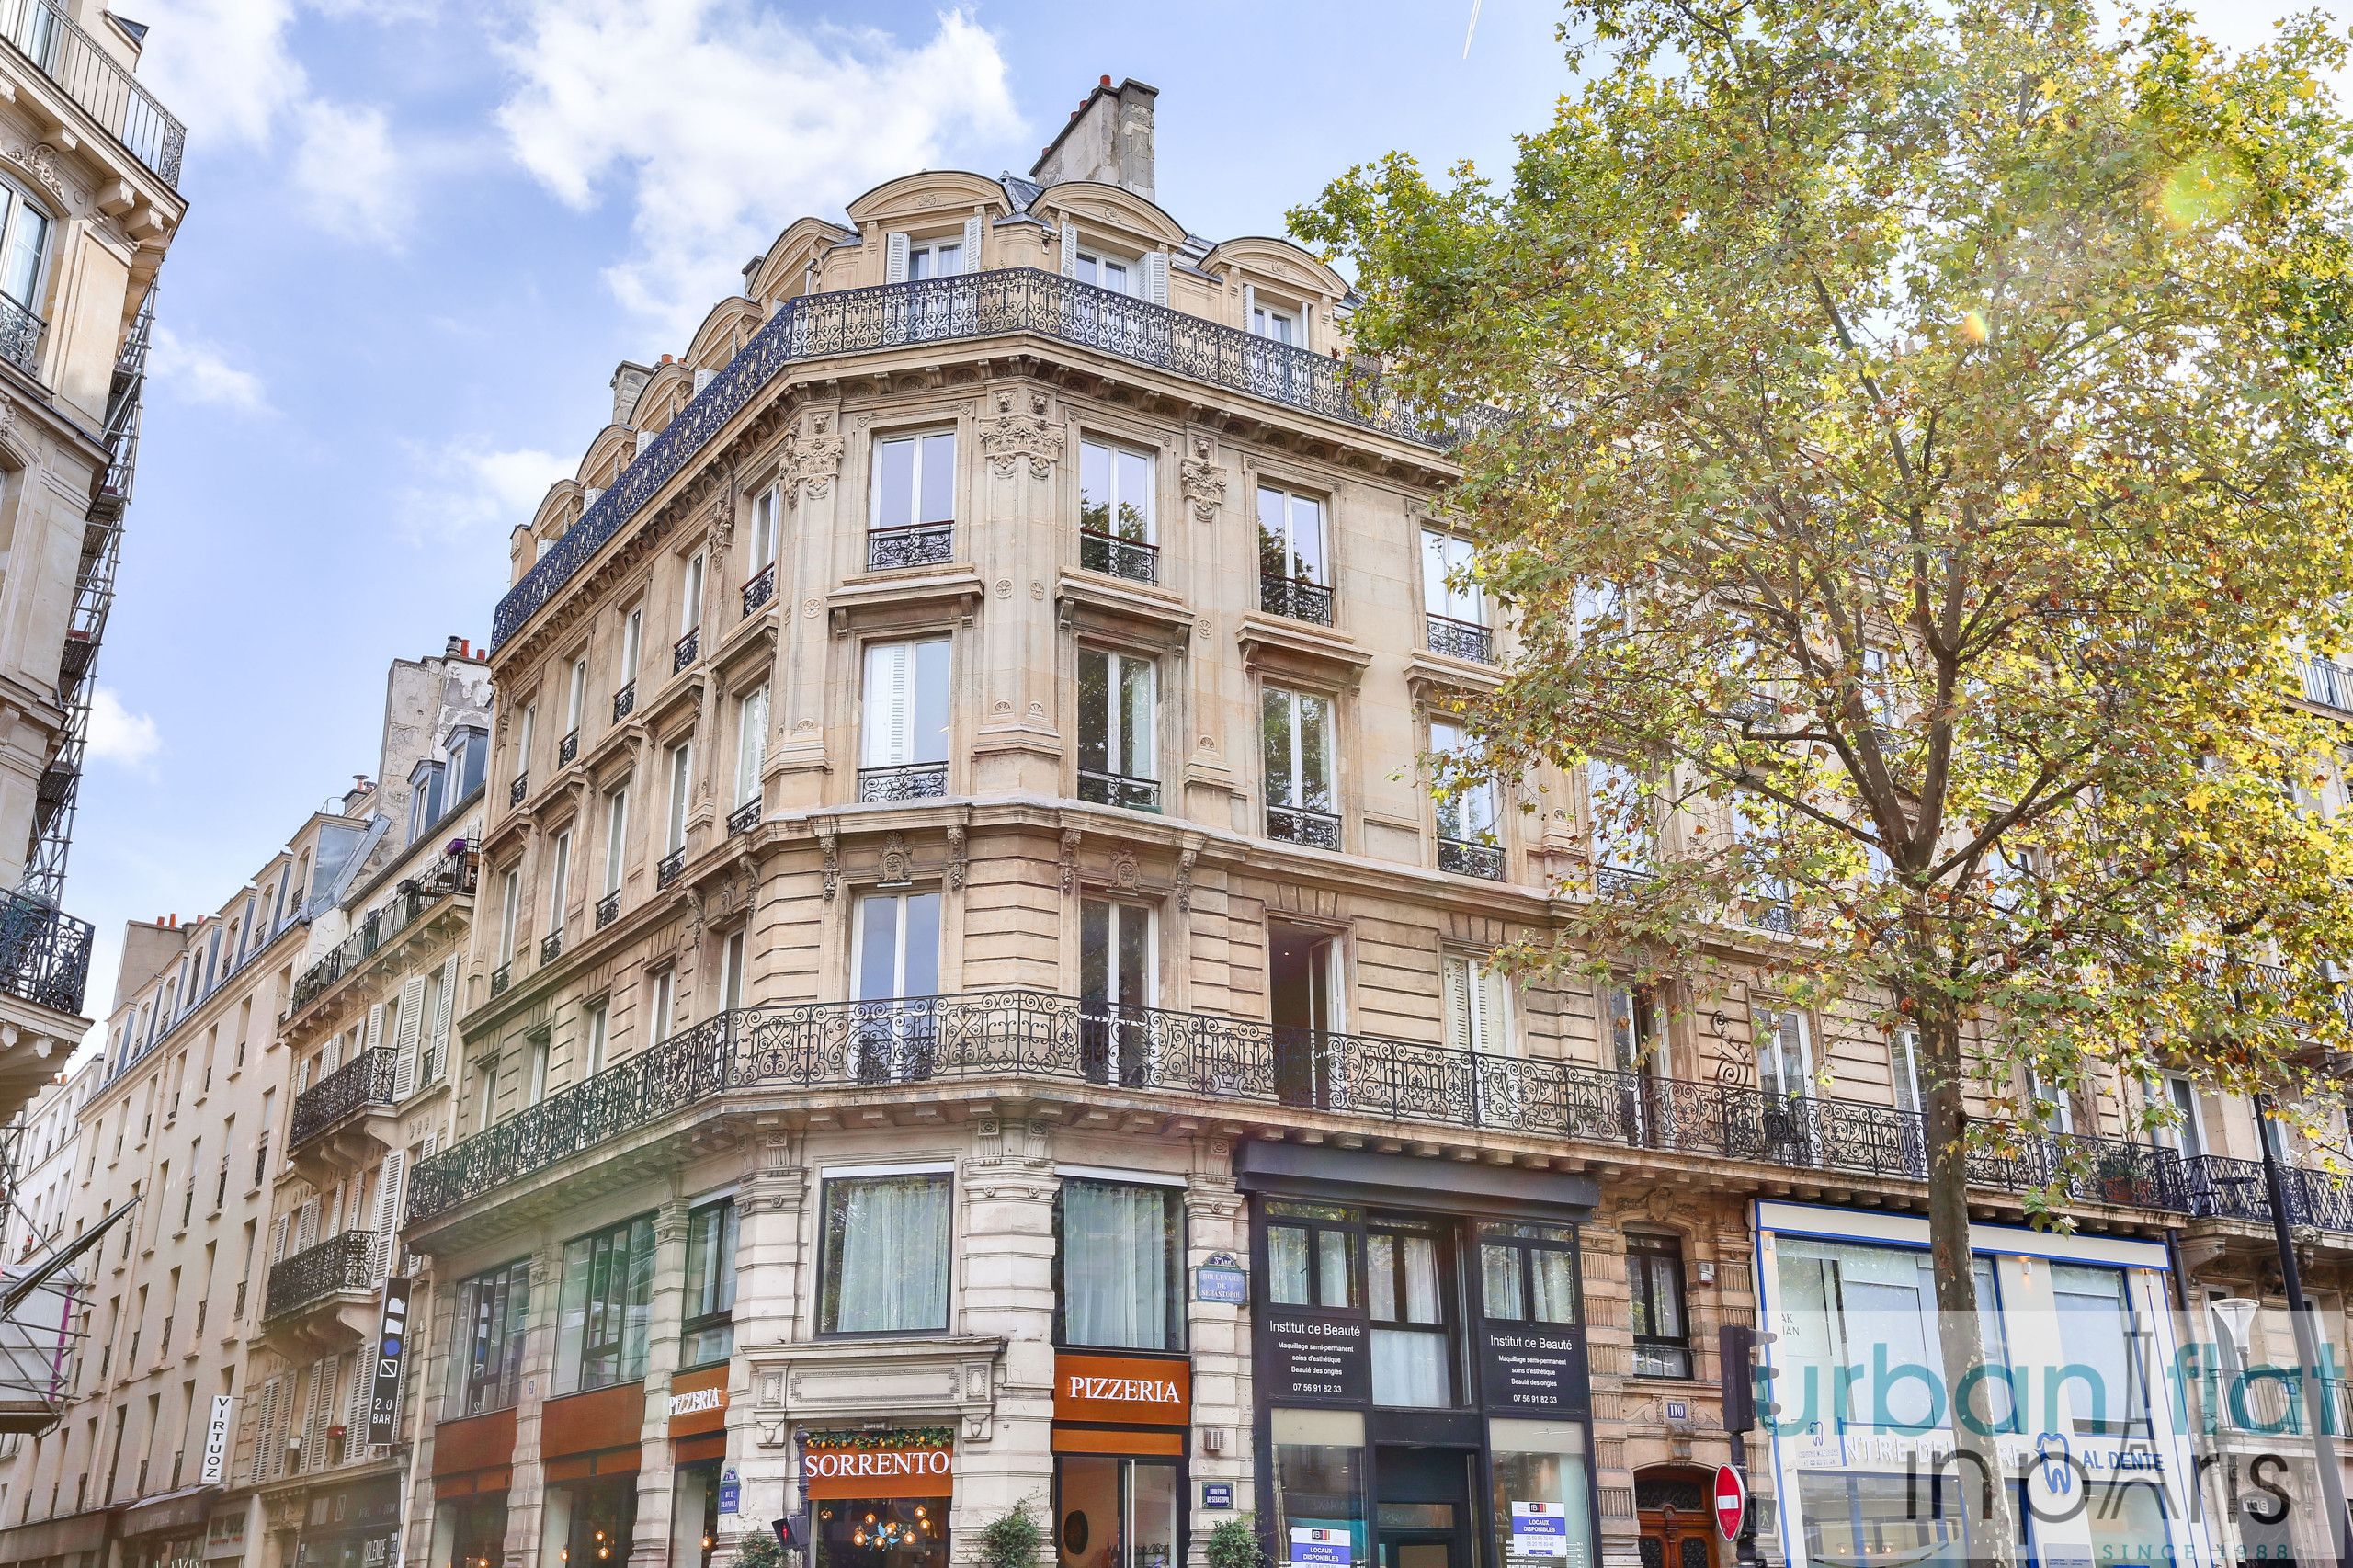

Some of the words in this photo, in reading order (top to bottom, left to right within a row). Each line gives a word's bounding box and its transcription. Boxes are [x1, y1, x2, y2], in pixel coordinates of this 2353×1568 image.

[1269, 1320, 1305, 1334] Institut
[1308, 1323, 1321, 1335] de
[1324, 1324, 1360, 1337] Beauté
[1278, 1341, 1309, 1351] Maquillage
[1309, 1344, 1354, 1353] semi-permanent
[1490, 1335, 1522, 1347] Institut
[1524, 1337, 1537, 1348] de
[1539, 1337, 1573, 1351] Beauté
[1308, 1355, 1341, 1364] d'esthétique
[1498, 1355, 1526, 1364] Maquillage
[1527, 1357, 1566, 1366] semi-permanent
[1290, 1365, 1312, 1374] Beauté
[1324, 1368, 1343, 1377] ongles
[1526, 1368, 1556, 1377] d'esthétique
[1292, 1382, 1302, 1392] 07
[1302, 1383, 1312, 1392] 56
[1313, 1383, 1322, 1392] 91
[1323, 1384, 1332, 1392] 82
[1333, 1385, 1342, 1393] 33
[1511, 1378, 1529, 1386] Beauté
[1540, 1380, 1557, 1388] ongles
[1069, 1376, 1181, 1403] PIZZERIA
[669, 1387, 722, 1416] PIZZERIA
[1513, 1394, 1521, 1403] 07
[1522, 1394, 1530, 1403] 56
[1540, 1395, 1549, 1403] 82
[1549, 1396, 1557, 1404] 33
[1670, 1404, 1684, 1417] 110
[372, 1413, 392, 1425] BAR
[206, 1397, 230, 1478] VIRTUOZ
[804, 1450, 950, 1478] SORRENTO
[2082, 1449, 2104, 1470] AL
[2108, 1450, 2165, 1472] DENTE
[2245, 1499, 2268, 1513] 108
[1310, 1546, 1333, 1554] LOCAUX
[1302, 1553, 1339, 1562] DISPONIBLES
